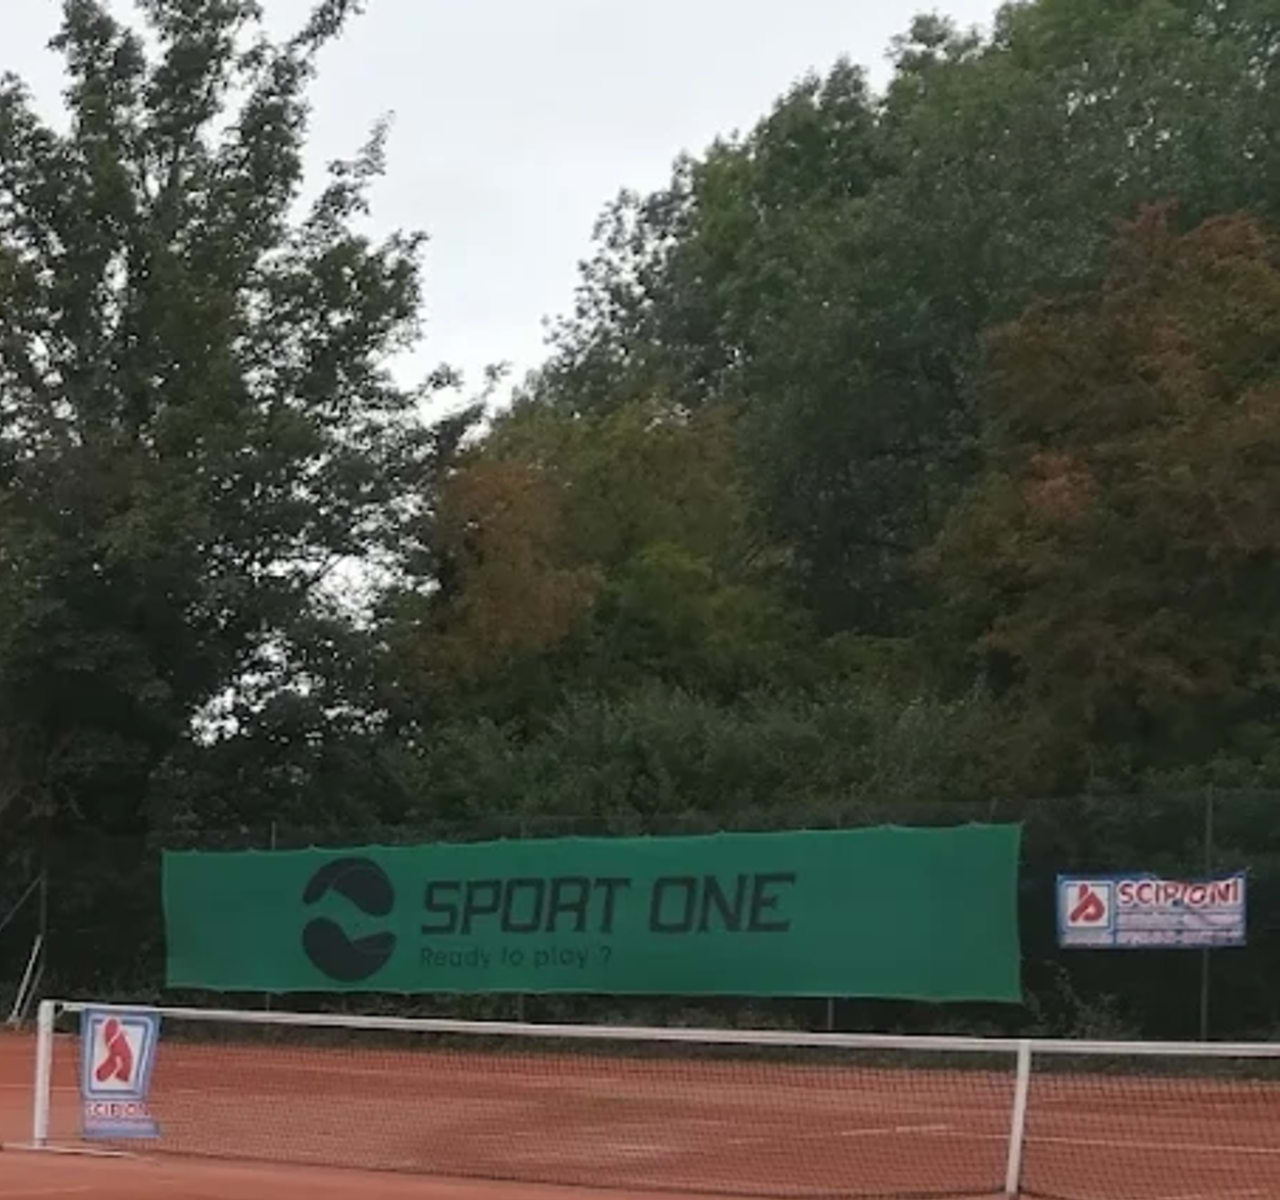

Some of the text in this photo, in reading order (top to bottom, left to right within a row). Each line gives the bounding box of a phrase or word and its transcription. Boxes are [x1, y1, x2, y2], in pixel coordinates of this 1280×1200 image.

[420, 872, 797, 934] SPORT ONE
[1118, 881, 1238, 906] SCIPIONI
[420, 945, 613, 969] Ready to play ?
